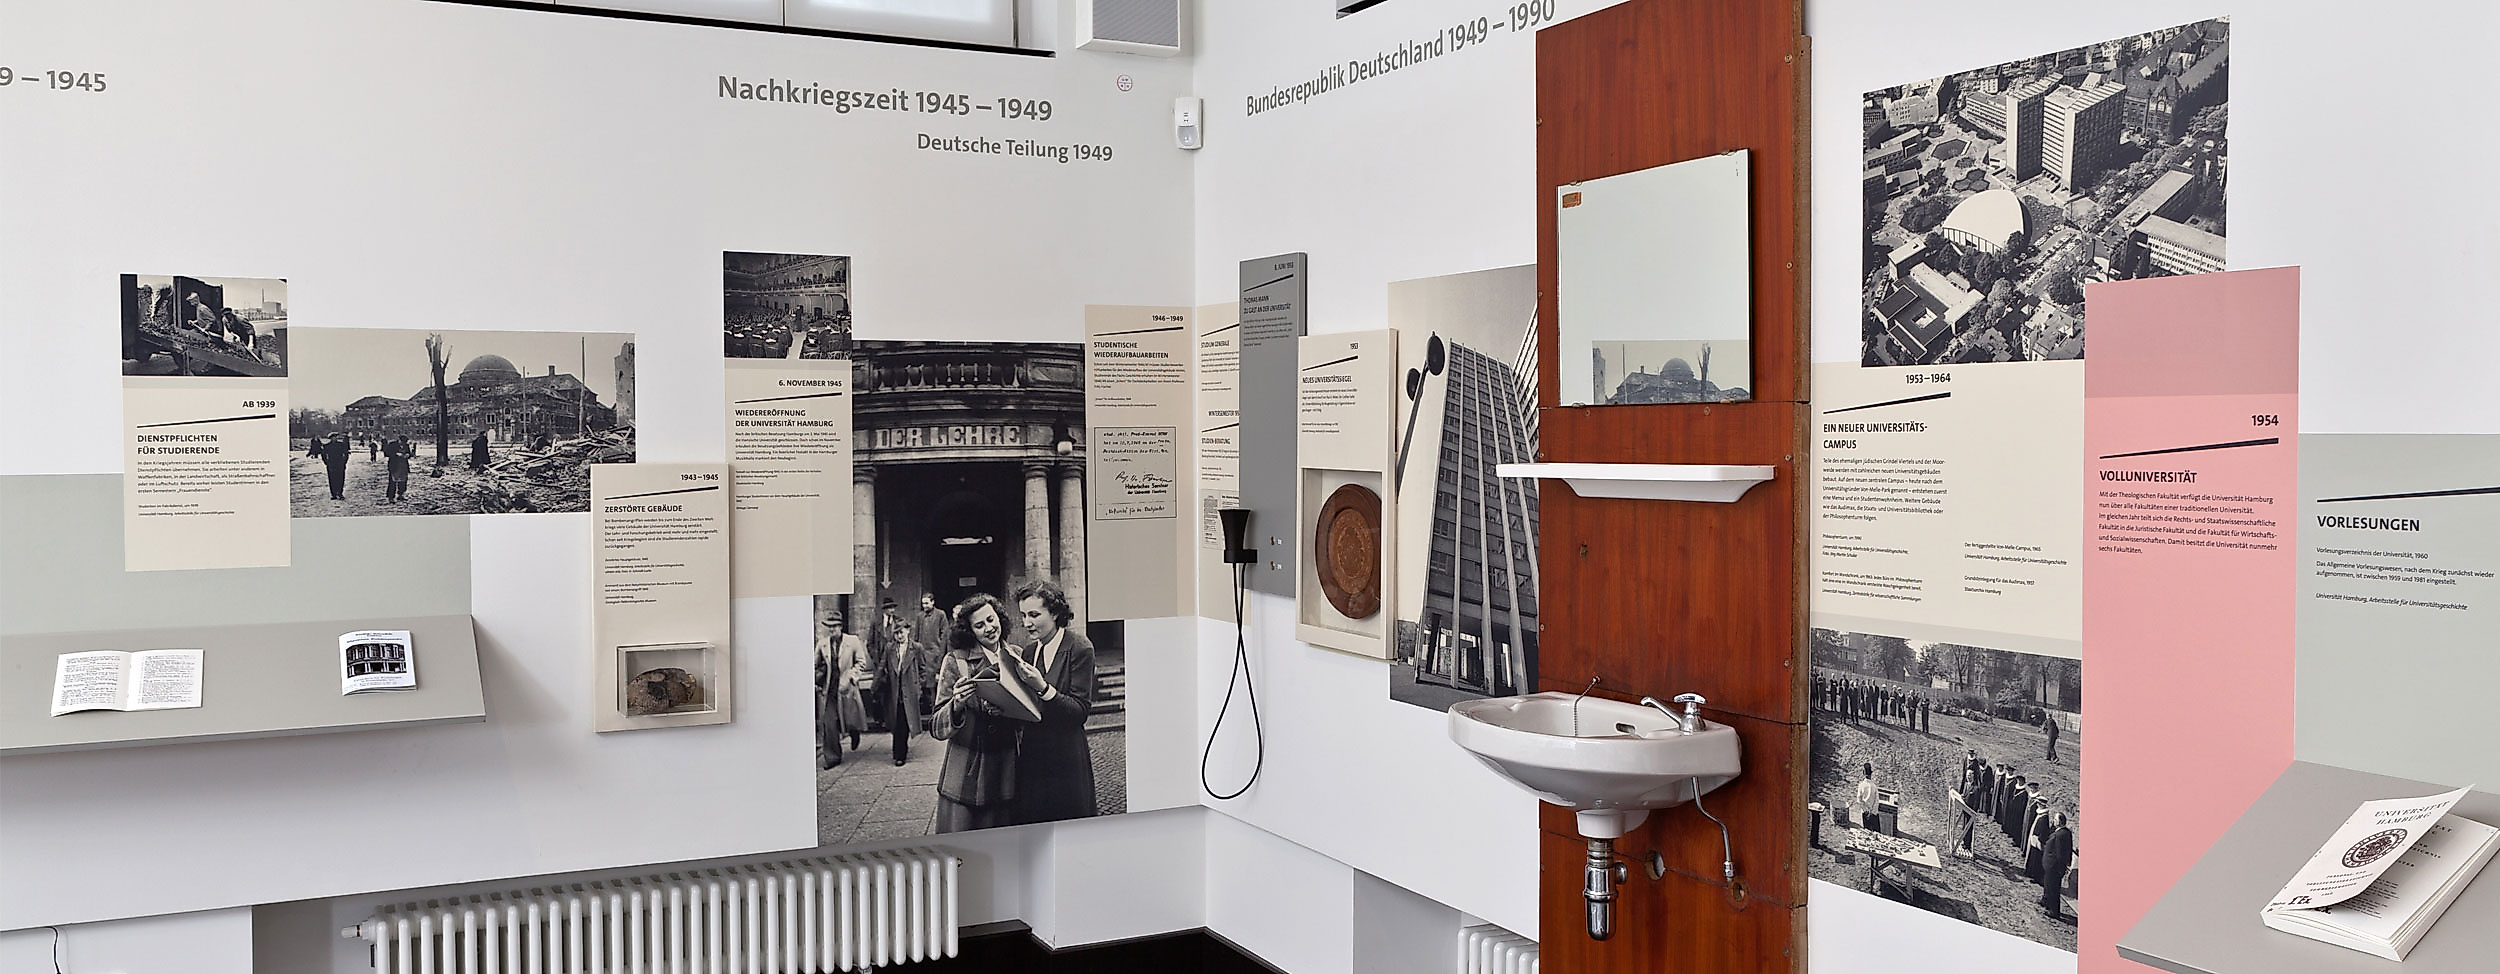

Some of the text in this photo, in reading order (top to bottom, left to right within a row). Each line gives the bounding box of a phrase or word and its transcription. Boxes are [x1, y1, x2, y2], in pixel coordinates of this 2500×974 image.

[1247, 0, 1556, 117] Bundesrepublik Deutschland 1949 – 1990
[0, 66, 14, 86] 9
[46, 70, 106, 92] 1945
[719, 76, 909, 114] Nachkriegszeit
[916, 92, 970, 116] 1945
[998, 98, 1052, 121] 1949
[918, 134, 1113, 164] Deutsche Teilung 1949
[1906, 373, 1951, 384] 1953–1964
[735, 409, 806, 417] WIEDERERÖFFNUNG
[751, 419, 796, 427] UNIVERSITÄT
[1824, 421, 1928, 433] EIN NEUER UNIVERSITÄTS-
[2252, 415, 2279, 426] 1954
[138, 435, 218, 443] DIENSTPFLICHTEN
[874, 424, 1022, 448] DER LEHRE
[138, 446, 220, 455] FÜR STUDIERENDE
[1824, 440, 1857, 449] CAMPUS
[2100, 470, 2198, 484] VOLLUNIVERSITÄT
[2118, 491, 2157, 500] Theologischen
[2180, 493, 2201, 503] verfügt
[2211, 494, 2244, 502] Universität
[2244, 495, 2274, 505] Hamburg
[605, 504, 682, 513] ZERSTÖRTE GEBÄUDE
[2134, 502, 2164, 511] Fakultäten
[2179, 504, 2219, 513] traditionellen
[2106, 513, 2129, 521] gleichen
[2173, 515, 2194, 523] Rechts-
[2206, 517, 2276, 528] Staatswissenschaftliche
[2317, 515, 2420, 532] VORLESUNGEN
[2098, 523, 2120, 531] Fakultät
[2134, 525, 2163, 533] Juristische
[2207, 528, 2231, 537] Fakultät
[2240, 530, 2278, 539] Wirtschafts-
[2109, 534, 2167, 545] Sozialwissenschaften.
[2167, 538, 2186, 546] Damit
[2185, 539, 2206, 547] besitzt
[2215, 541, 2249, 550] Universität
[2113, 545, 2143, 554] Fakultäten.
[2316, 547, 2372, 556] Vorlesungsverzeichnis
[2382, 551, 2414, 559] Universität,
[2326, 561, 2356, 570] Allgemeine
[2356, 563, 2404, 574] Vorlesungswesen,
[2432, 568, 2447, 577] Krieg
[2316, 568, 2356, 579] aufgenommen,
[2363, 571, 2388, 581] zwischen
[2426, 575, 2457, 586] eingestellt.
